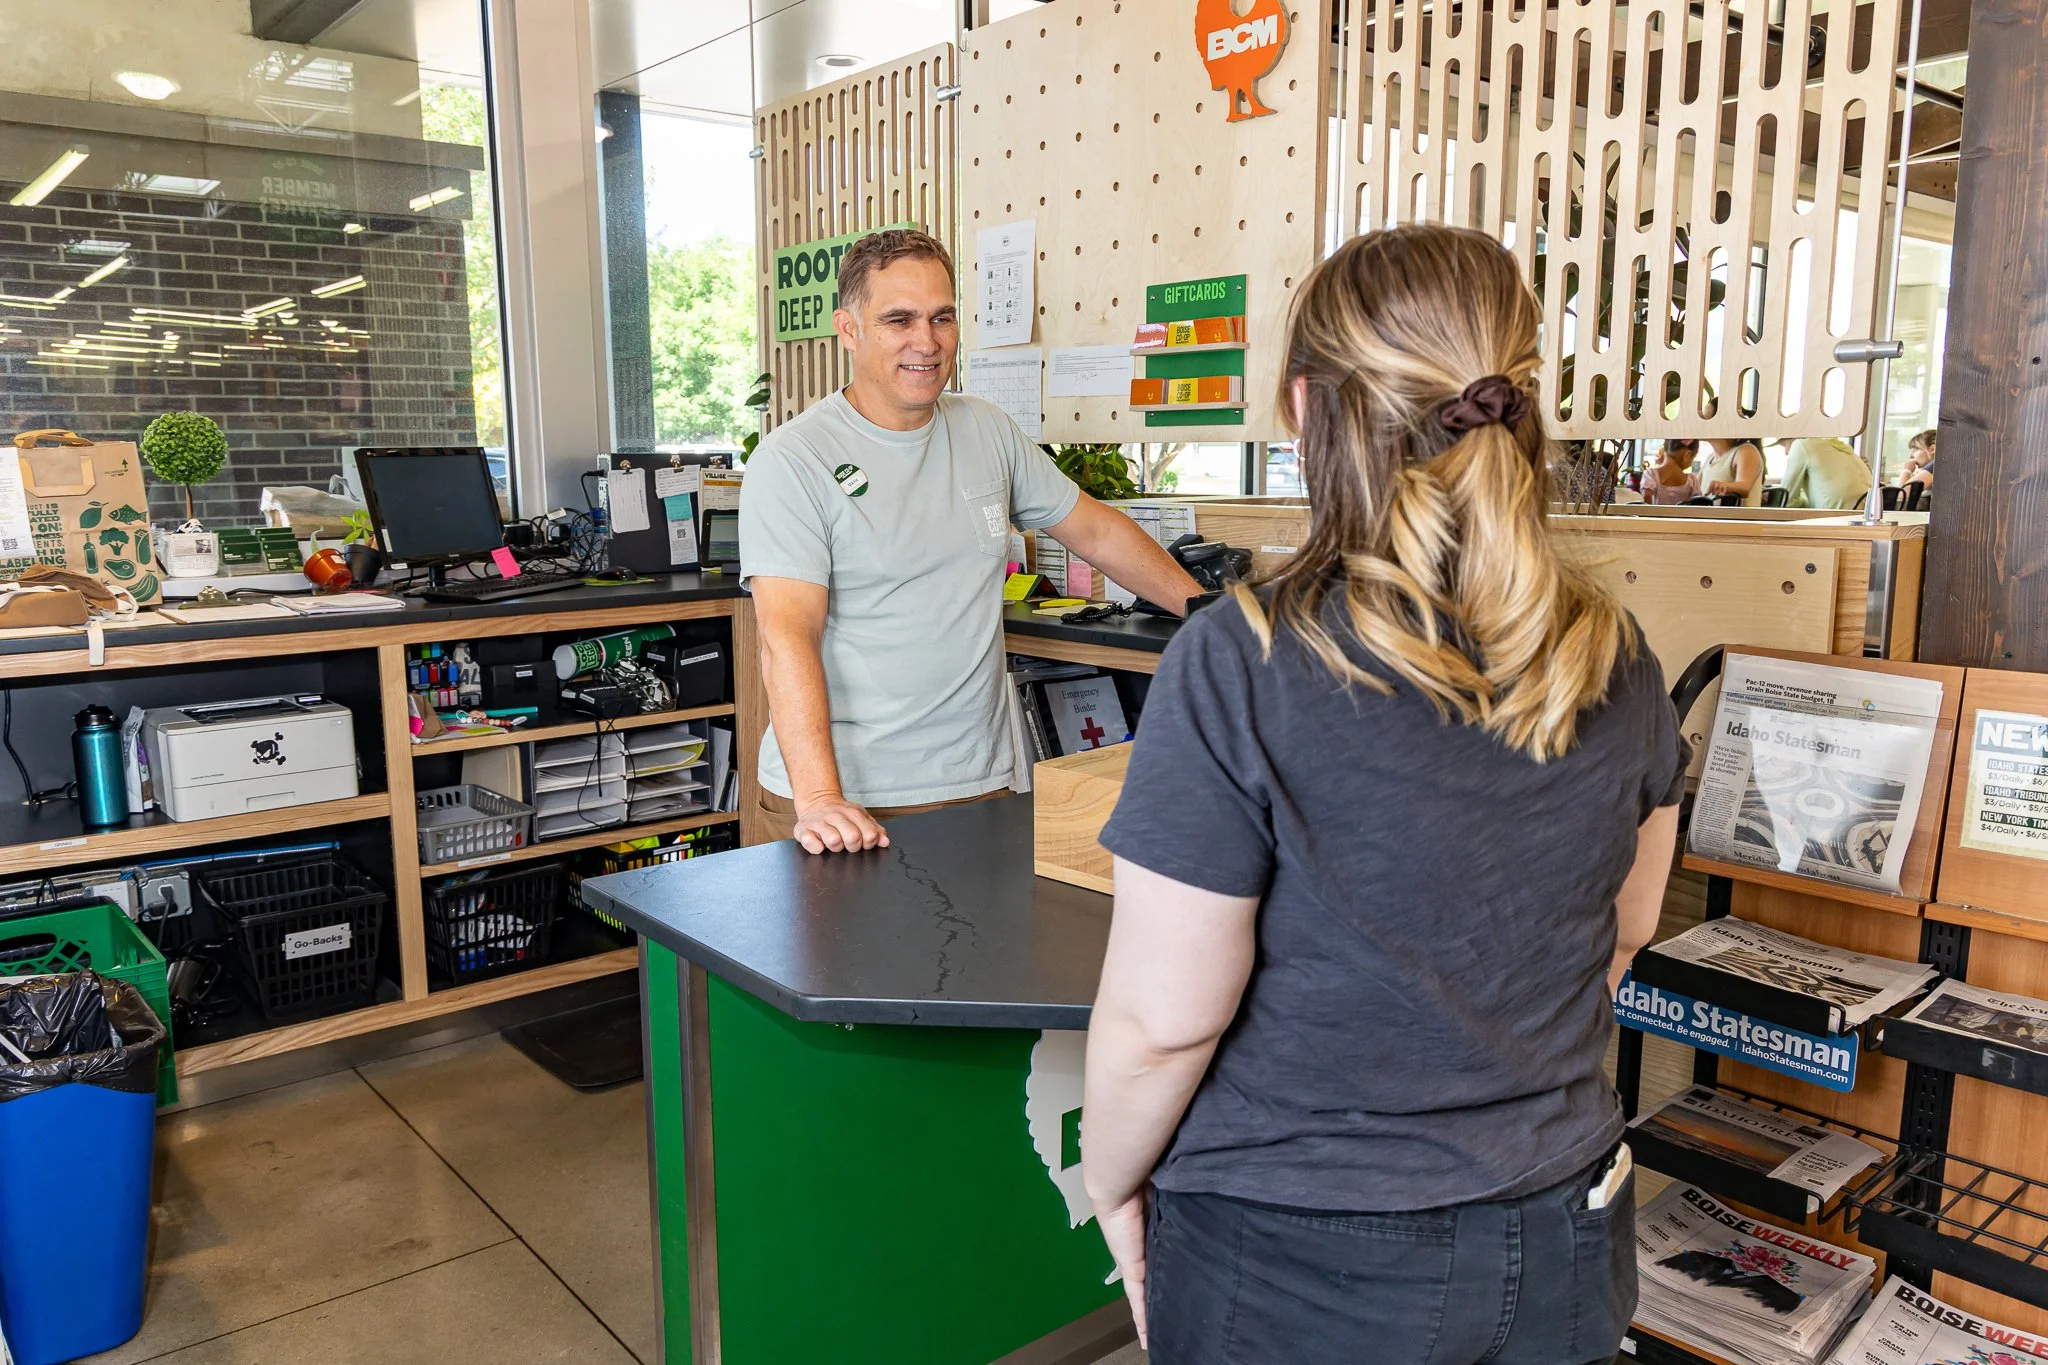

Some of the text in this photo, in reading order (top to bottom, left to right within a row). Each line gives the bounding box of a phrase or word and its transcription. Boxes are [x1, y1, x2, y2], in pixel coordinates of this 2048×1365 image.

[1207, 13, 1278, 61] BCM
[778, 242, 852, 290] ROOT
[1164, 281, 1226, 304] GIFTCARDS
[779, 294, 823, 333] DEEP
[50, 547, 65, 555] IN
[1062, 687, 1100, 700] Emergency
[1745, 678, 1837, 700] Pac-12 move, revenue sharing
[1746, 685, 1764, 693] strain
[1783, 690, 1799, 699] State
[1800, 693, 1825, 704] budget,
[1073, 703, 1097, 714] Binder
[1726, 721, 1861, 760] Idaho Statesman
[1989, 759, 2014, 773] IDAHO
[1987, 771, 2024, 785] $3/Daily
[1985, 785, 2012, 797] IDAHO
[1984, 798, 2021, 811] $3/Daily
[1982, 811, 2005, 823] NEW
[2006, 814, 2029, 827] YORK
[1981, 823, 2019, 837] $4/Daily
[1733, 850, 1777, 866] Meridian
[294, 935, 343, 949] Go-Backs
[1710, 926, 1754, 946] Idaho
[1756, 945, 1845, 973] Statesman
[1691, 1000, 1850, 1072] Statesman
[1627, 1010, 1675, 1032] connected.
[1677, 1024, 1689, 1036] Be
[1689, 1030, 1730, 1049] engaged.
[1742, 1043, 1848, 1084] IdahoStatesman.com
[1698, 1103, 1760, 1127] IDAHO
[1760, 1124, 1817, 1146] PRESS
[1801, 1156, 1834, 1171] funding
